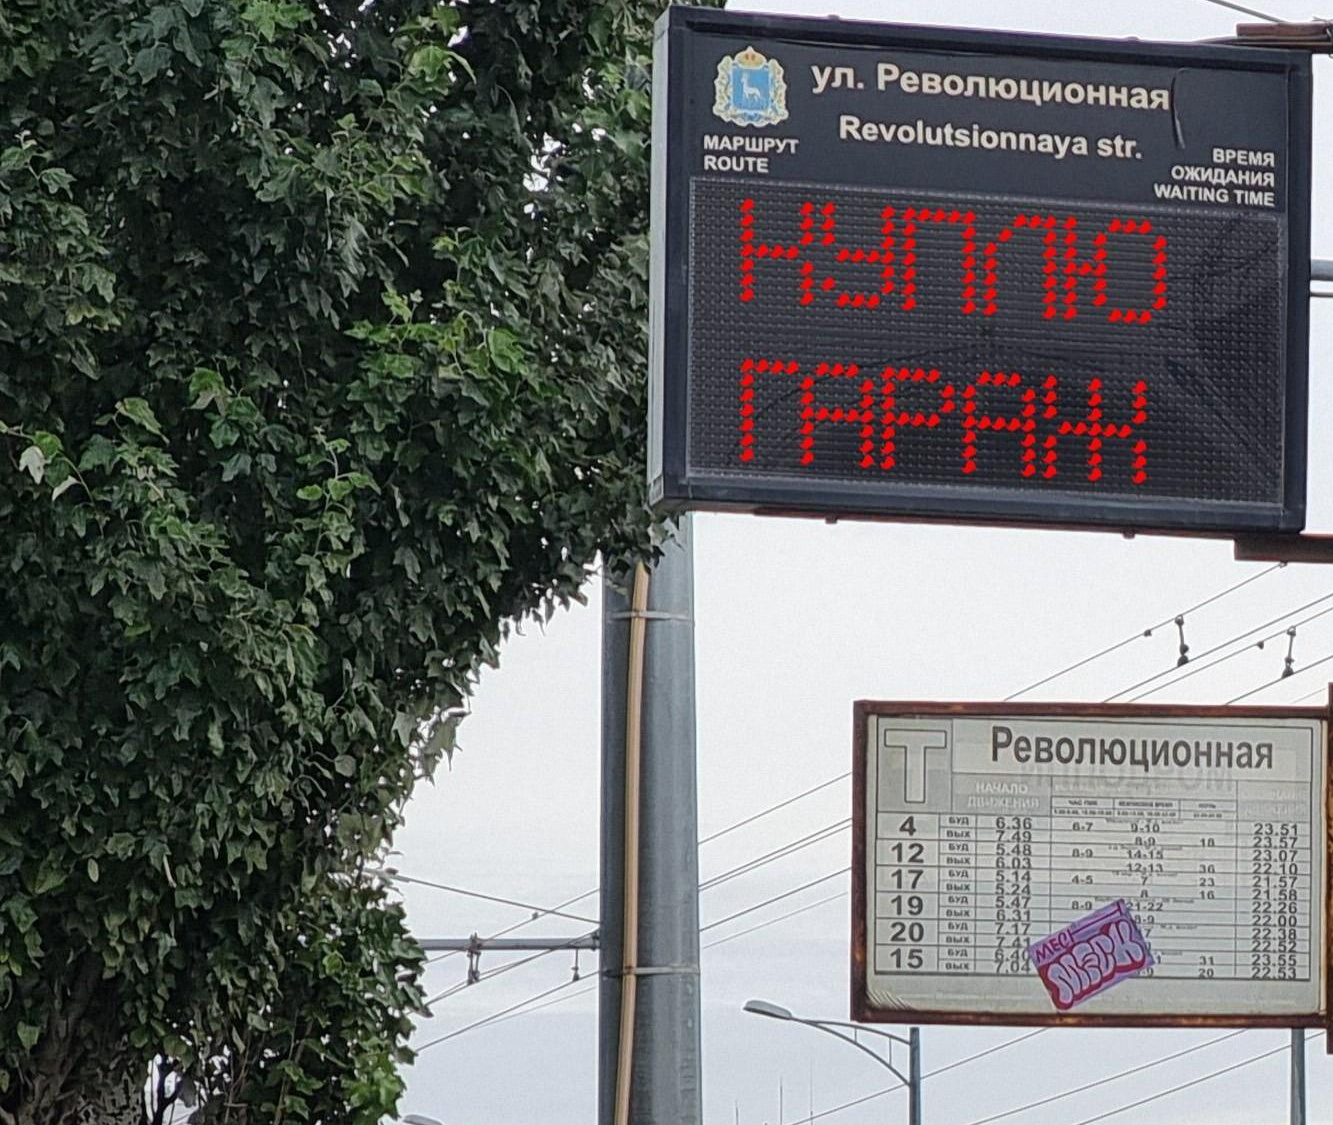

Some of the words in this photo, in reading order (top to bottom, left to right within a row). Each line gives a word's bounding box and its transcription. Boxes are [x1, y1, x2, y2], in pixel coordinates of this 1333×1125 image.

[811, 62, 864, 93] ул.
[876, 63, 1171, 111] Революционная
[703, 133, 799, 154] МАРШРУТ
[839, 115, 1089, 160] Revolutsionnaya
[1097, 135, 1143, 160] str.
[703, 155, 769, 174] ROUTE
[1213, 148, 1276, 167] ВРЕМЯ
[1171, 166, 1276, 188] ОЖИДАНИЯ
[1154, 183, 1230, 204] WAITING
[1233, 189, 1276, 206] TIME
[740, 357, 1149, 485] ГАРАЖ
[992, 726, 1273, 773] Революционная
[975, 782, 1029, 793] НАЧАЛО
[967, 796, 1040, 808] ДВИЖЕНИЯ
[899, 815, 916, 836] 4
[948, 816, 969, 825] БУД
[995, 816, 1033, 830] 6.36
[1254, 823, 1298, 836] 23.51
[946, 830, 970, 838] ВЫХ
[996, 830, 1032, 843] 7.49
[1252, 837, 1298, 849] 23.57
[891, 842, 924, 863] 12
[948, 843, 969, 852] БУД
[995, 843, 1032, 856] 5.48
[1252, 850, 1298, 862] 23.07
[946, 856, 970, 865] ВЫХ
[995, 856, 1032, 870] 6.03
[1252, 863, 1298, 875] 22.10
[891, 869, 924, 890] 17
[948, 869, 969, 878] БУД
[995, 870, 1031, 882] 5.14
[1252, 876, 1298, 888] 21.57
[946, 883, 970, 891] ВЫХ
[995, 883, 1031, 895] 5.24
[1251, 888, 1298, 901] 21.58
[891, 895, 923, 916] 19
[948, 896, 968, 905] БУД
[995, 896, 1031, 909] 5.47
[1252, 901, 1297, 914] 22.26
[946, 909, 970, 917] ВЫХ
[995, 909, 1031, 922] 6.31
[1252, 914, 1297, 927] 22.00
[890, 921, 924, 942] 20
[947, 922, 968, 931] БУД
[995, 922, 1031, 935] 7.17
[1252, 928, 1297, 940] 22.38
[995, 936, 1031, 949] 7.41
[1252, 940, 1297, 953] 22.52
[890, 948, 923, 969] 15
[947, 948, 968, 957] БУД
[1252, 953, 1297, 966] 23.55
[945, 962, 970, 970] ВЫХ
[994, 960, 1031, 974] 7.04
[1252, 967, 1297, 980] 22.53
